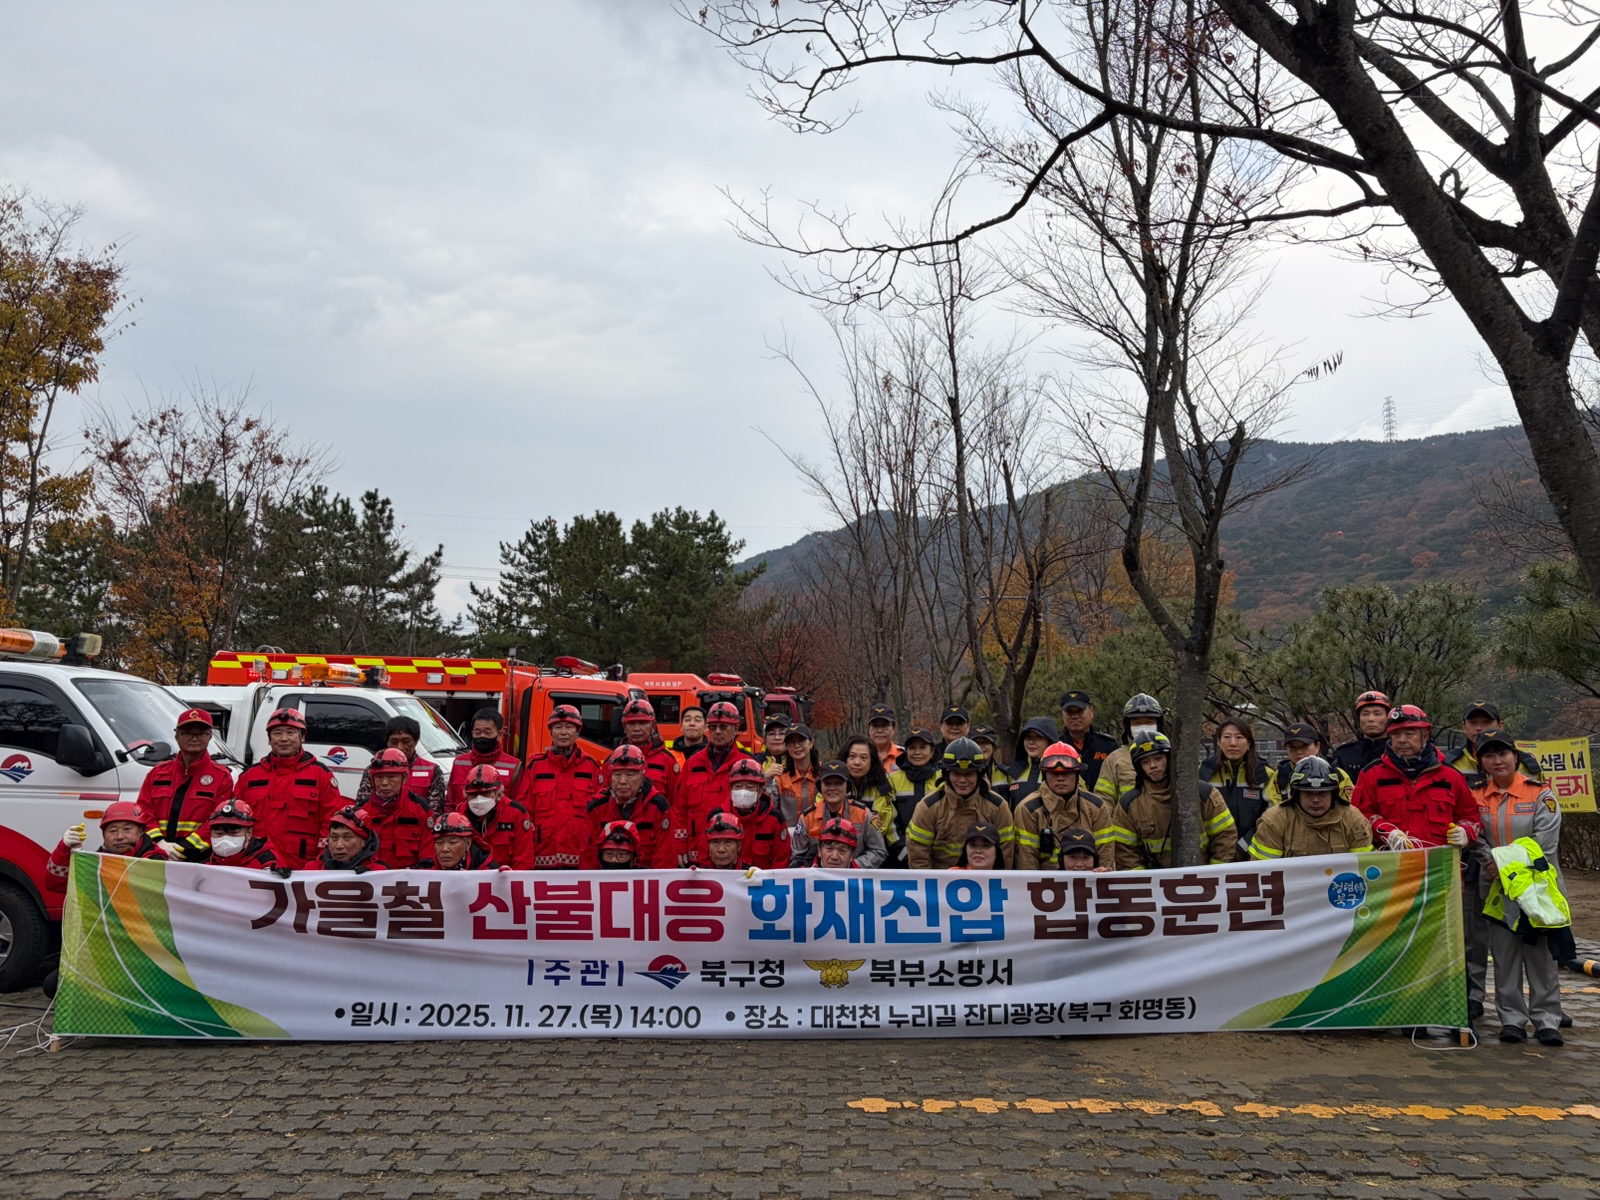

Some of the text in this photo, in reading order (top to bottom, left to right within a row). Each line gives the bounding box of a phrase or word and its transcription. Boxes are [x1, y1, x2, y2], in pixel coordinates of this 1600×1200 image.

[1541, 750, 1585, 771] 산림 내
[1555, 774, 1589, 796] 금지
[248, 870, 1287, 944] 가을철 산불대응 화재진압 합동훈련
[1334, 893, 1360, 907] 북구
[700, 959, 786, 988] 북구청
[869, 958, 1014, 988] 북부소방서
[350, 1001, 399, 1027] 일시
[417, 1003, 496, 1028] 2025.
[504, 1004, 530, 1028] 11.
[629, 1005, 702, 1029] 14:00
[744, 1004, 789, 1030] 장소
[810, 1004, 881, 1030] 대천천
[887, 1004, 958, 1028] 누리길
[963, 1000, 1112, 1027] 잔디광장(북구
[1117, 996, 1198, 1022] 화명동)
